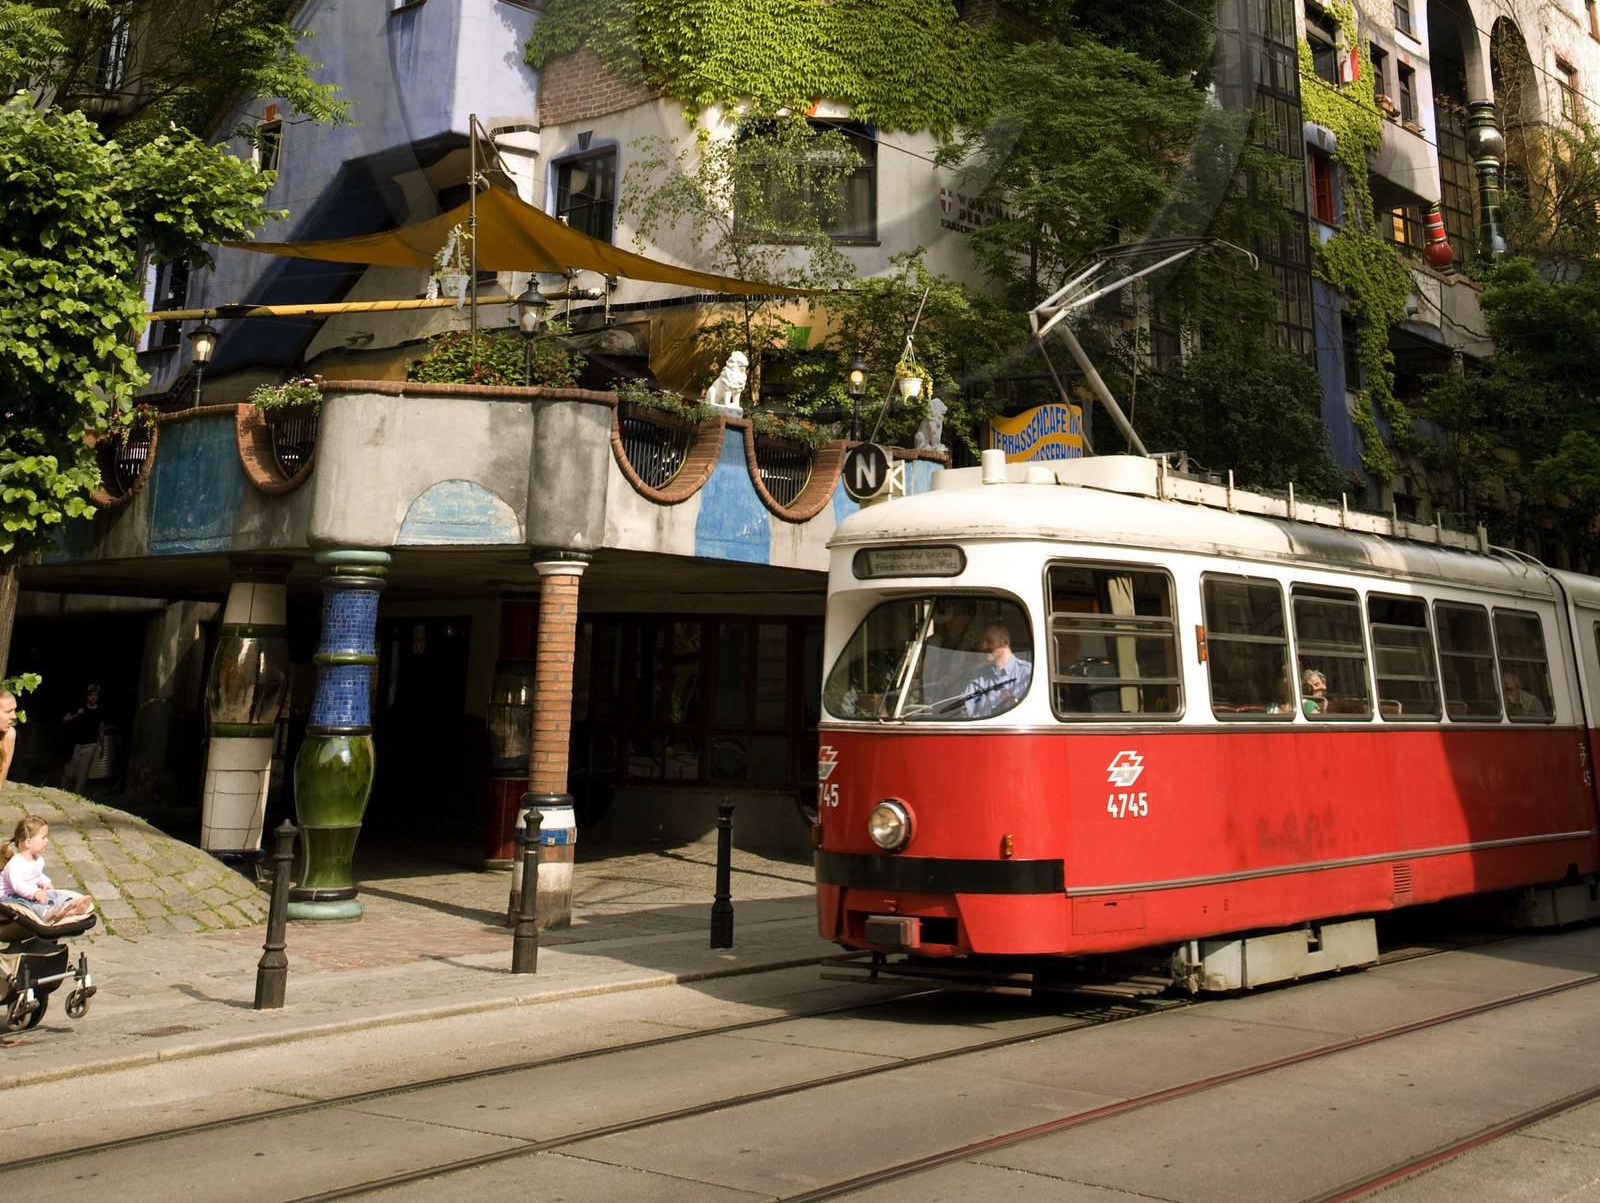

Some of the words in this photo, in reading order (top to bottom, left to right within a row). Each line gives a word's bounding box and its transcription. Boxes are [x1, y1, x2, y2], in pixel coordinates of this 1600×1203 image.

[958, 208, 982, 226] DER
[991, 405, 1067, 455] TERRASSENCAFE
[856, 452, 876, 489] N
[818, 783, 839, 807] 745
[1106, 792, 1149, 818] 4745
